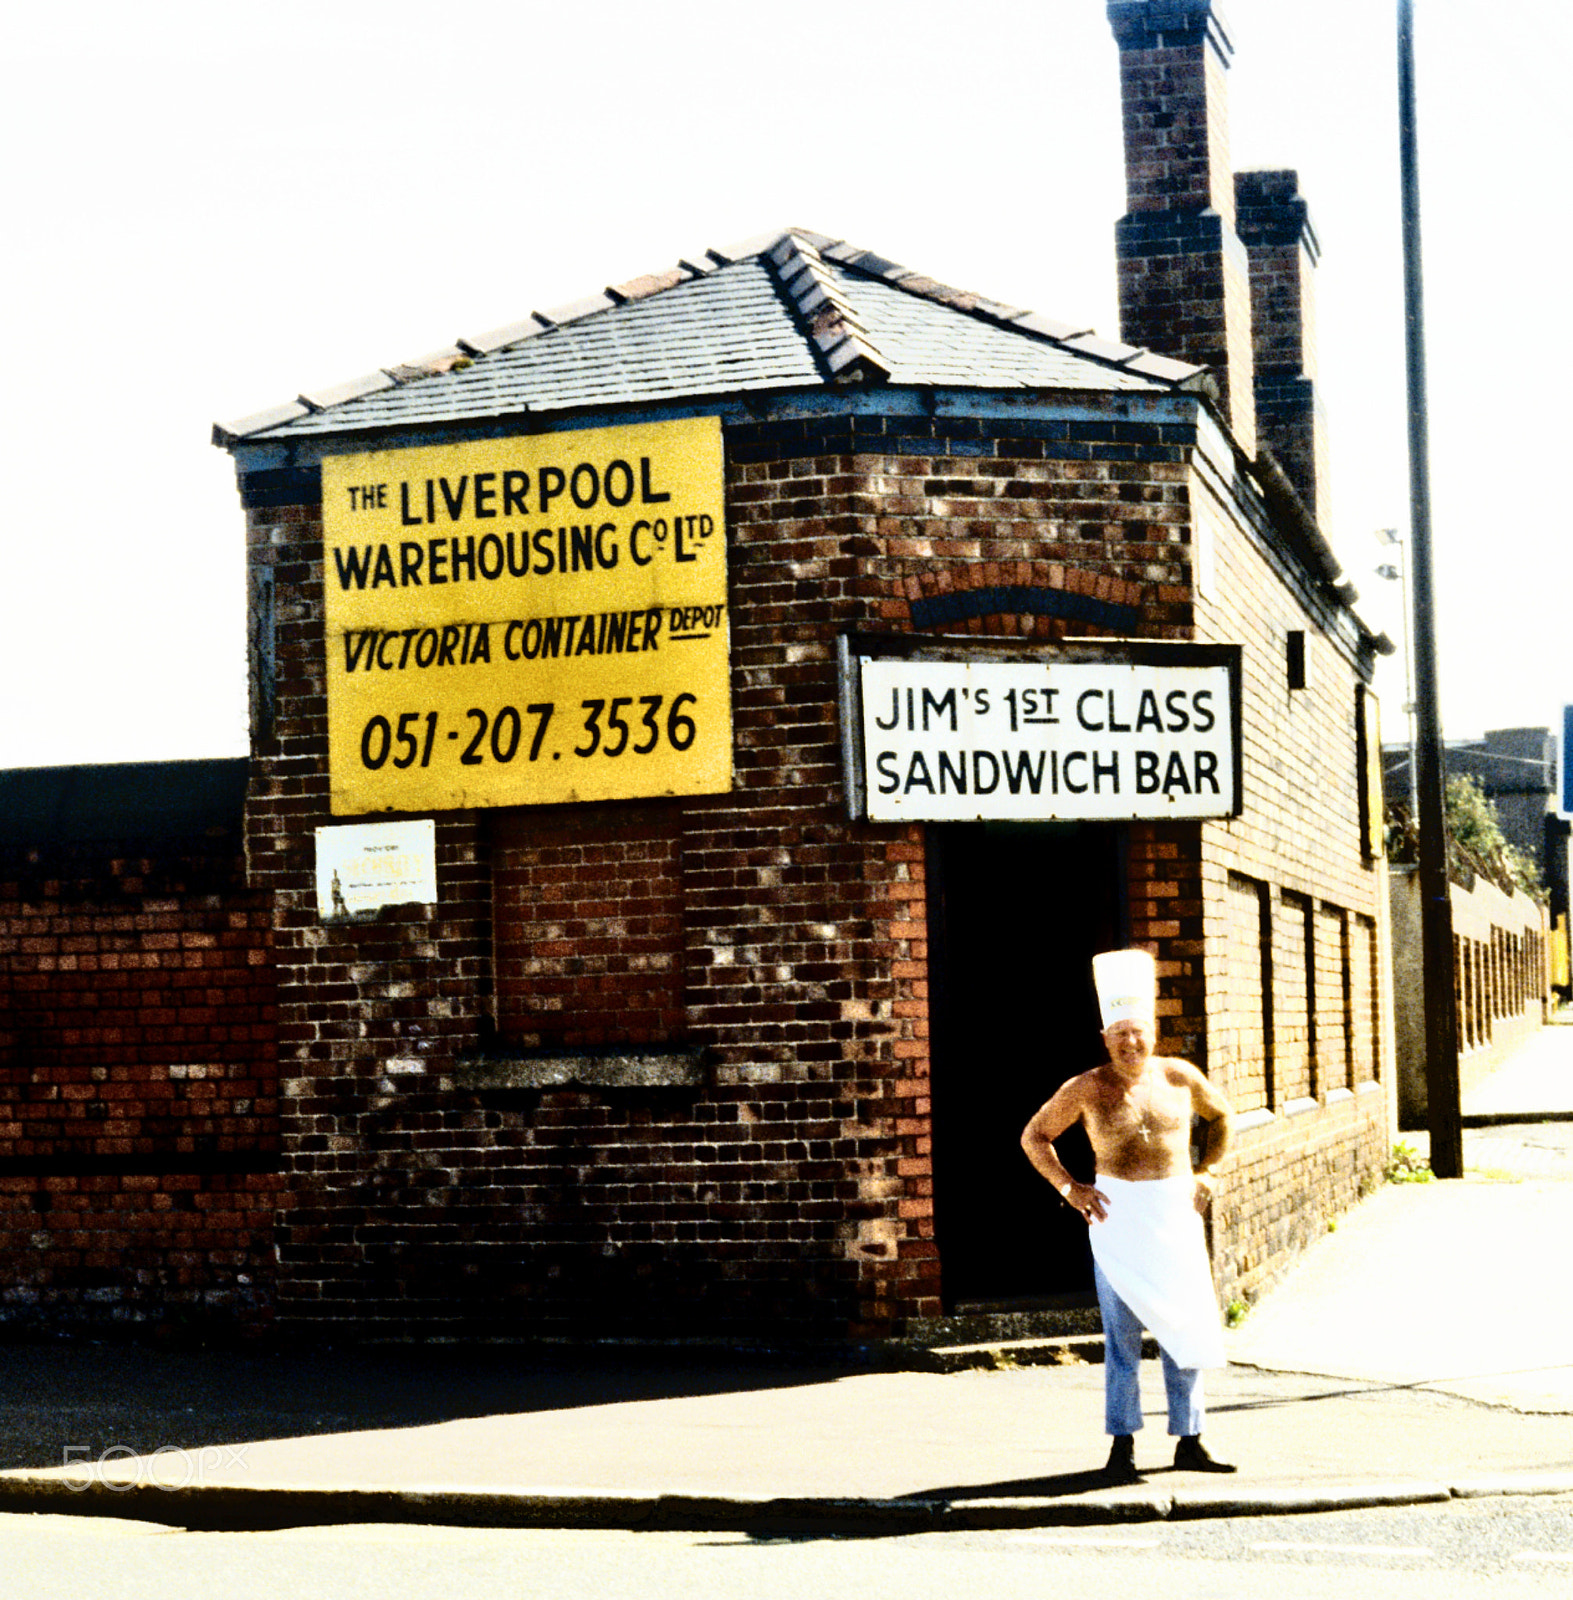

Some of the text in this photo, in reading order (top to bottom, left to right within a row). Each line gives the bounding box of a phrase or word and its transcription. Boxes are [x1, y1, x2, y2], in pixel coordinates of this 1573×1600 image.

[346, 456, 671, 526] THE LIVERPOOL
[333, 522, 619, 591] WAREHOUSING
[342, 604, 725, 673] VICTORIA CONTAINER DEPOT
[875, 687, 1216, 733] JIM'S 1ST CLASS
[876, 750, 1221, 795] SANDWICH BAR
